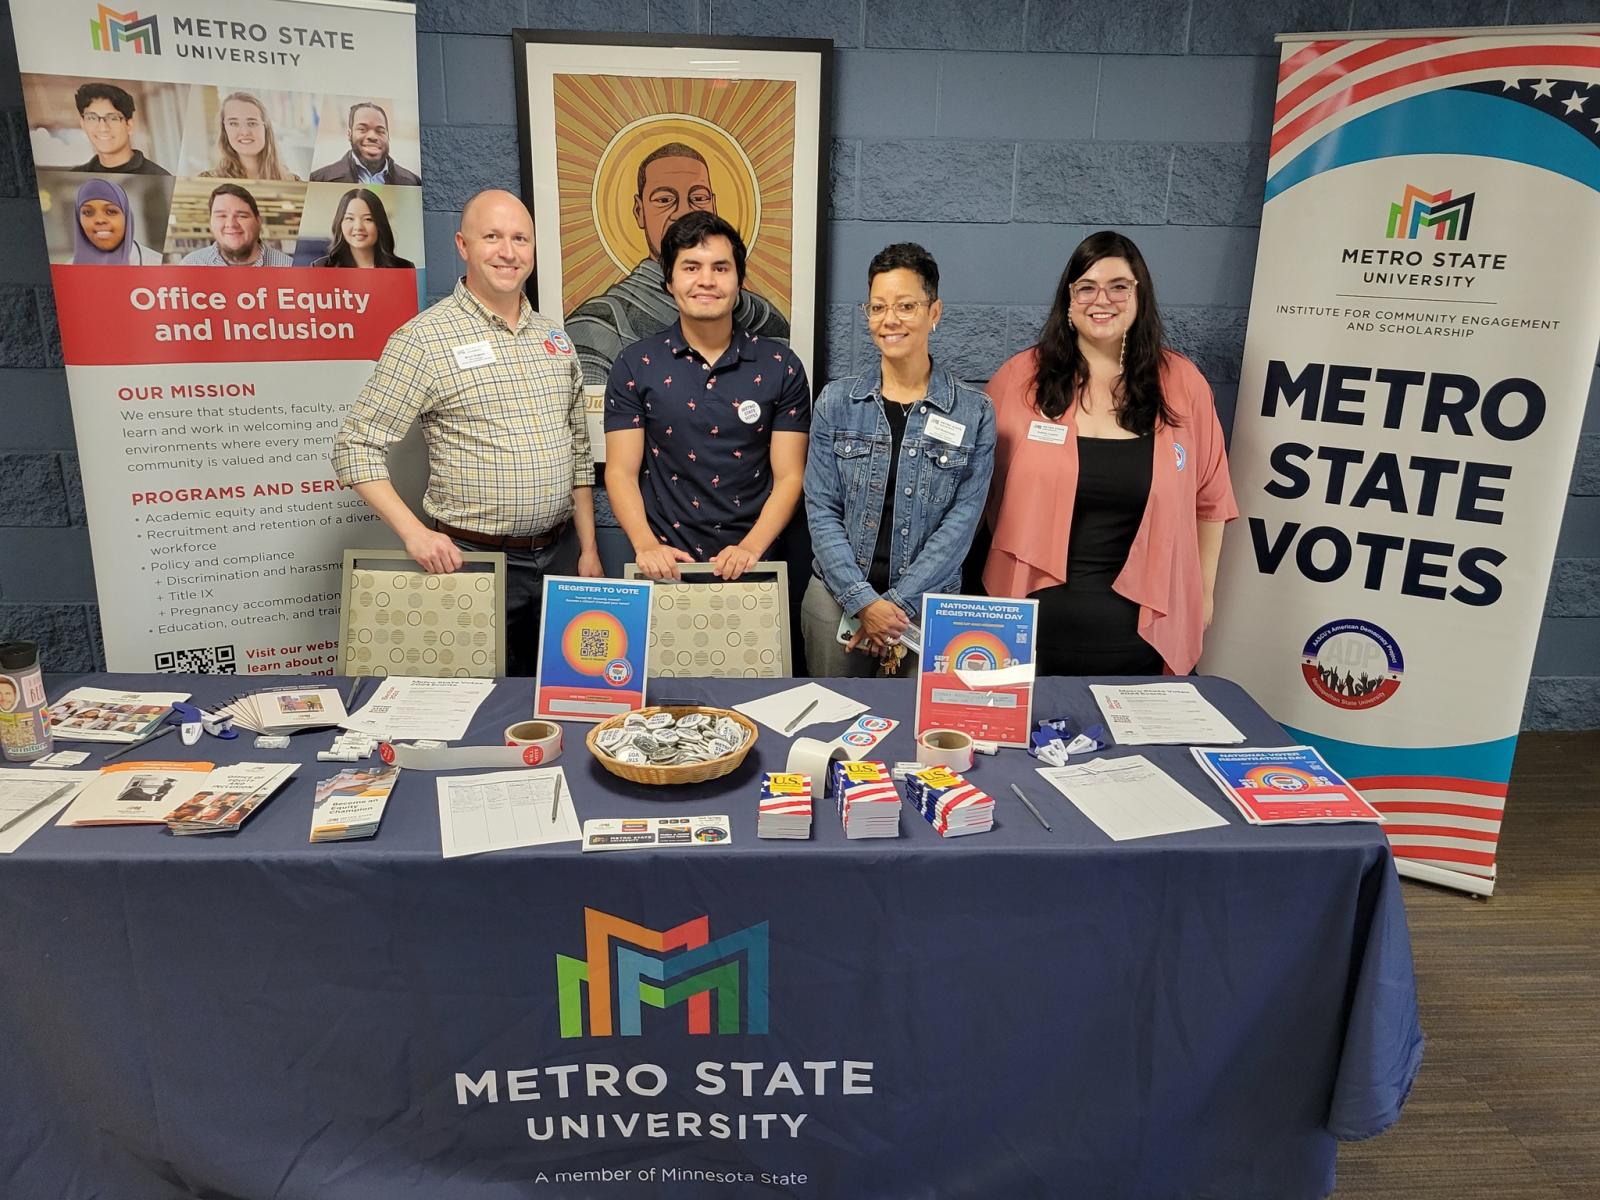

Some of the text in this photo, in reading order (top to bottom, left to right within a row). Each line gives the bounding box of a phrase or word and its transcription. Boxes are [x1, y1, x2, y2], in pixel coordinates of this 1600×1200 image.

[173, 16, 355, 51] METRO STATE
[175, 44, 302, 67] UNIVERSITY
[1340, 248, 1507, 270] METRO STATE
[1363, 272, 1476, 288] UNIVERSITY
[130, 287, 370, 314] Office of Equity
[1276, 305, 1560, 331] INSTITUTE FOR COMMUNITY ENGAGEMENT
[155, 319, 354, 342] and Inclusion
[1346, 322, 1474, 338] AND SCHOLARSHIP
[118, 384, 256, 401] OUR MISSION
[1260, 359, 1546, 441] METRO
[121, 403, 352, 421] We ensure that students, faculty, an
[123, 419, 338, 438] learn and work in welcoming and
[126, 435, 336, 455] environments where every mem
[127, 457, 203, 472] community
[208, 456, 218, 467] is
[223, 453, 264, 466] valued
[268, 453, 292, 463] and
[296, 452, 317, 462] can
[132, 479, 354, 506] PROGRAMS AND SERV
[1263, 442, 1512, 525] STATE
[146, 499, 368, 524] Academic equity and student succ
[147, 513, 381, 540] Recruitment and retention of a divers
[151, 542, 217, 555] workforce
[151, 550, 295, 572] Policy and compliance
[1248, 517, 1507, 606] VOTES
[167, 561, 344, 586] Discrimination and harassme
[168, 589, 214, 601] Title IX
[558, 584, 601, 593] REGISTER
[170, 592, 341, 619] Pregnancy accommodation
[935, 609, 1004, 620] REGISTRATION
[940, 602, 1020, 613] NATIONAL VOTER
[158, 607, 341, 635] Education, outreach, and trai
[246, 641, 339, 659] Visit our webs
[247, 662, 280, 673] learn
[285, 656, 323, 669] about
[310, 667, 334, 676] and
[774, 776, 800, 785] U.S.
[921, 771, 949, 781] U.S.
[455, 1060, 874, 1105] METRO STATE
[527, 1113, 808, 1141] UNIVERSITY
[535, 1167, 808, 1185] A member of Minnesota State
